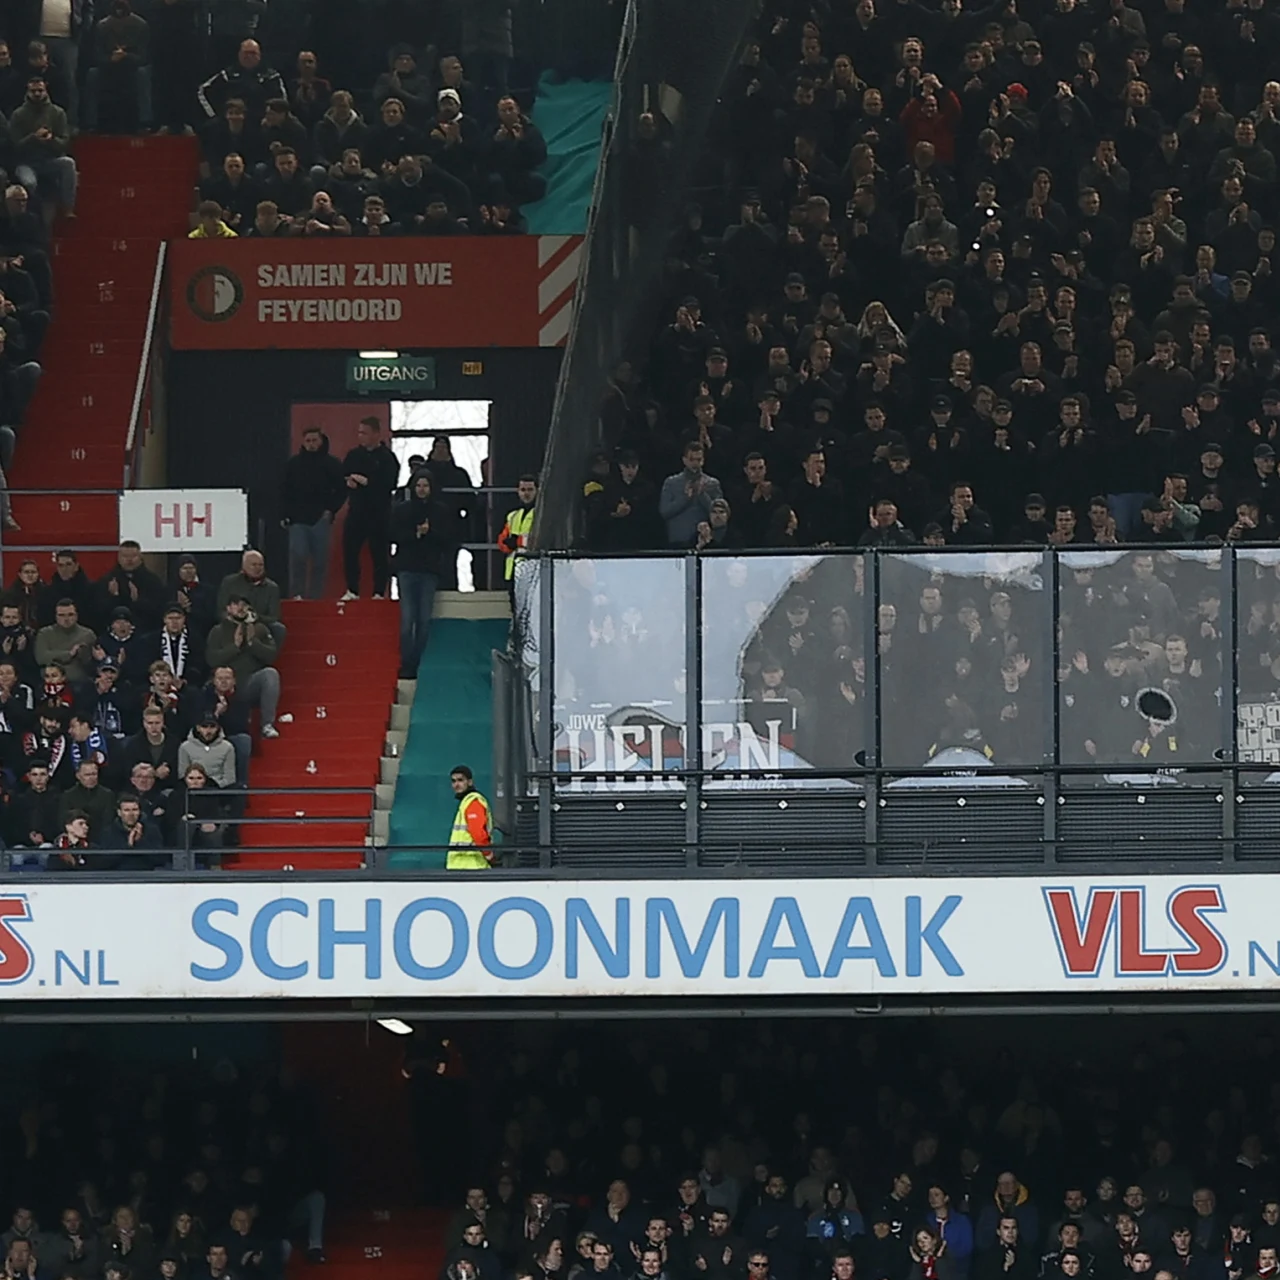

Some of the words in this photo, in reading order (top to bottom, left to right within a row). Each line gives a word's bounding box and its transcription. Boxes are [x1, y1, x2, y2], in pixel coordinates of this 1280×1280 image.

[257, 264, 346, 287] SAMEN
[353, 263, 408, 286] ZIJN
[414, 262, 453, 286] WE
[258, 299, 402, 322] FEYENOORD
[354, 366, 429, 381] UITGANG
[154, 502, 213, 537] HH
[190, 897, 964, 981] SCHOONMAAK
